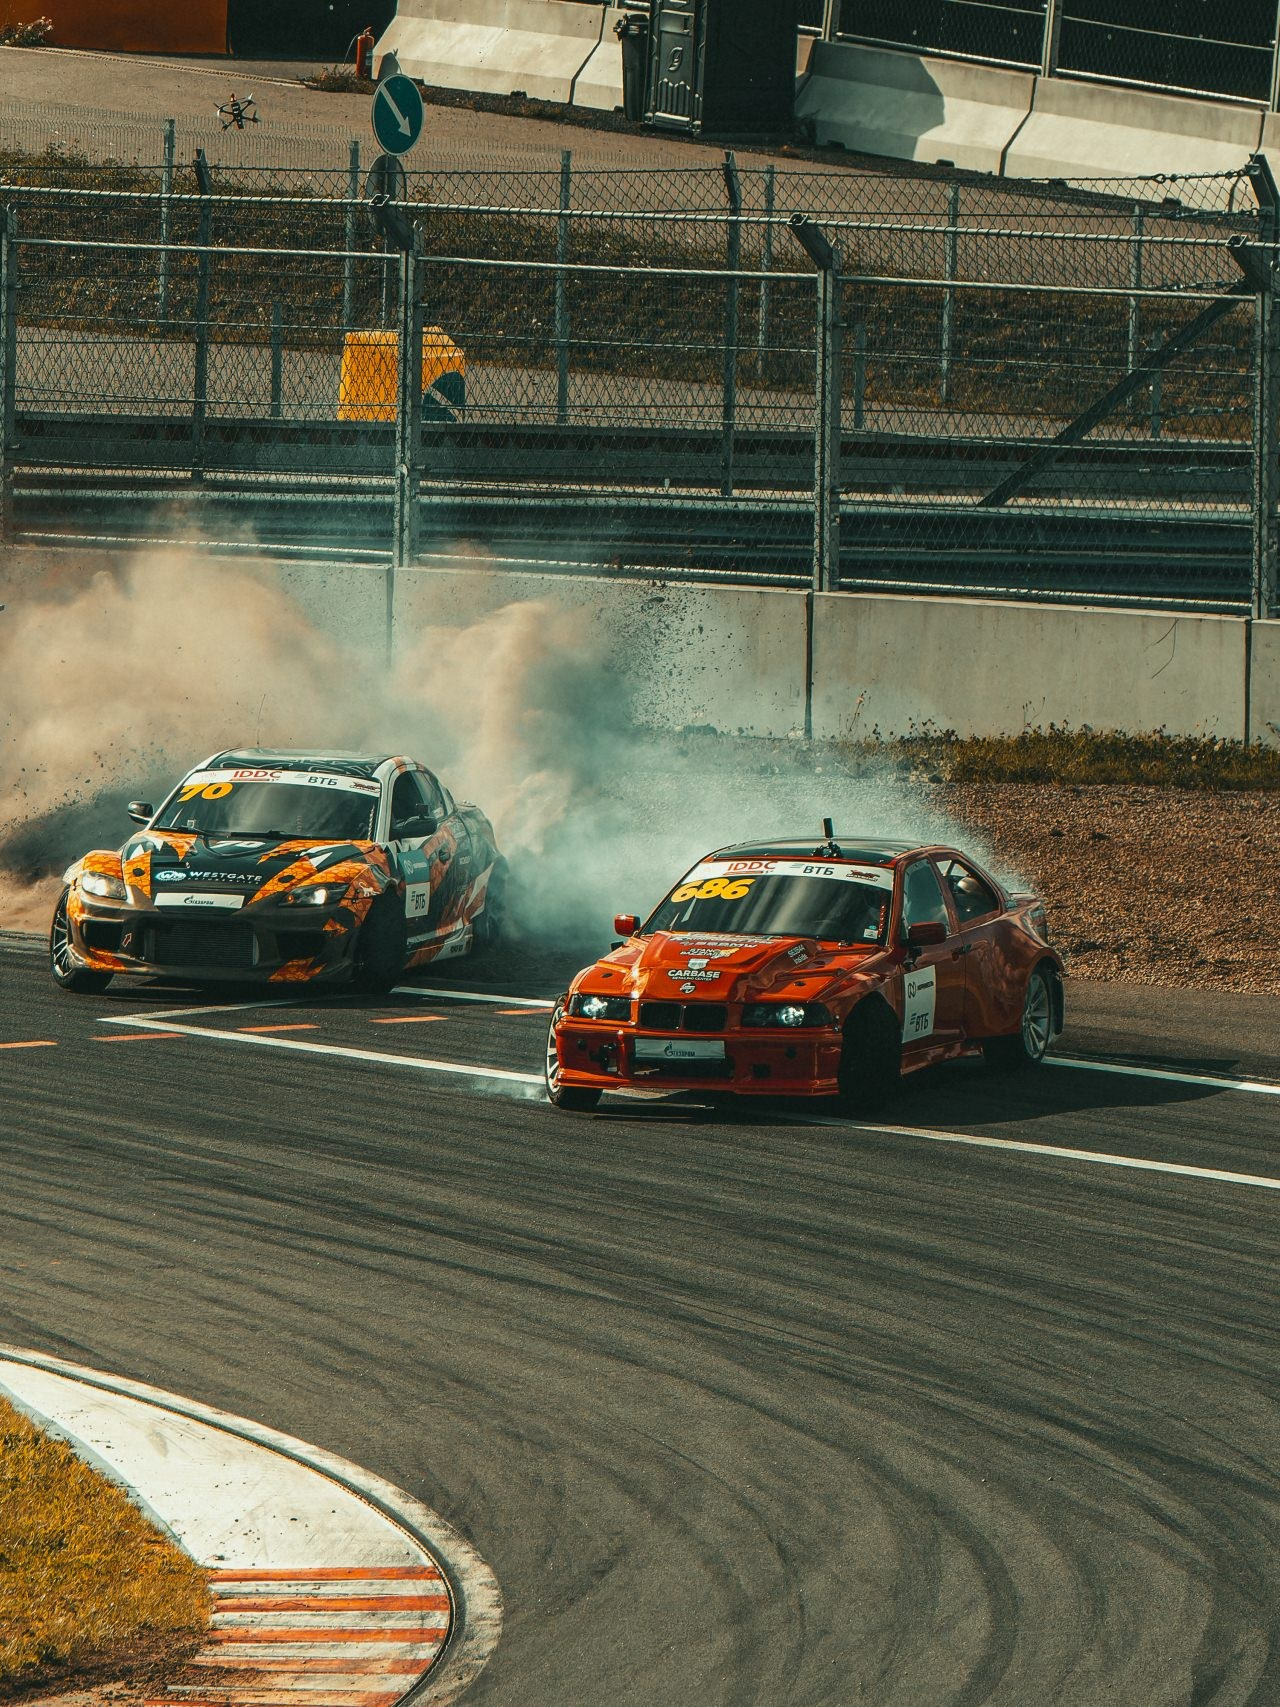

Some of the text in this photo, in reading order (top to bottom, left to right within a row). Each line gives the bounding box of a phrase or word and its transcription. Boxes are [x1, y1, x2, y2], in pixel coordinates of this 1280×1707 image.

[233, 770, 282, 779] IDDC
[177, 782, 233, 802] 70
[727, 860, 778, 871] IDDC
[189, 871, 263, 882] WESTGATE
[671, 878, 756, 903] 686
[667, 969, 721, 979] CARBASE
